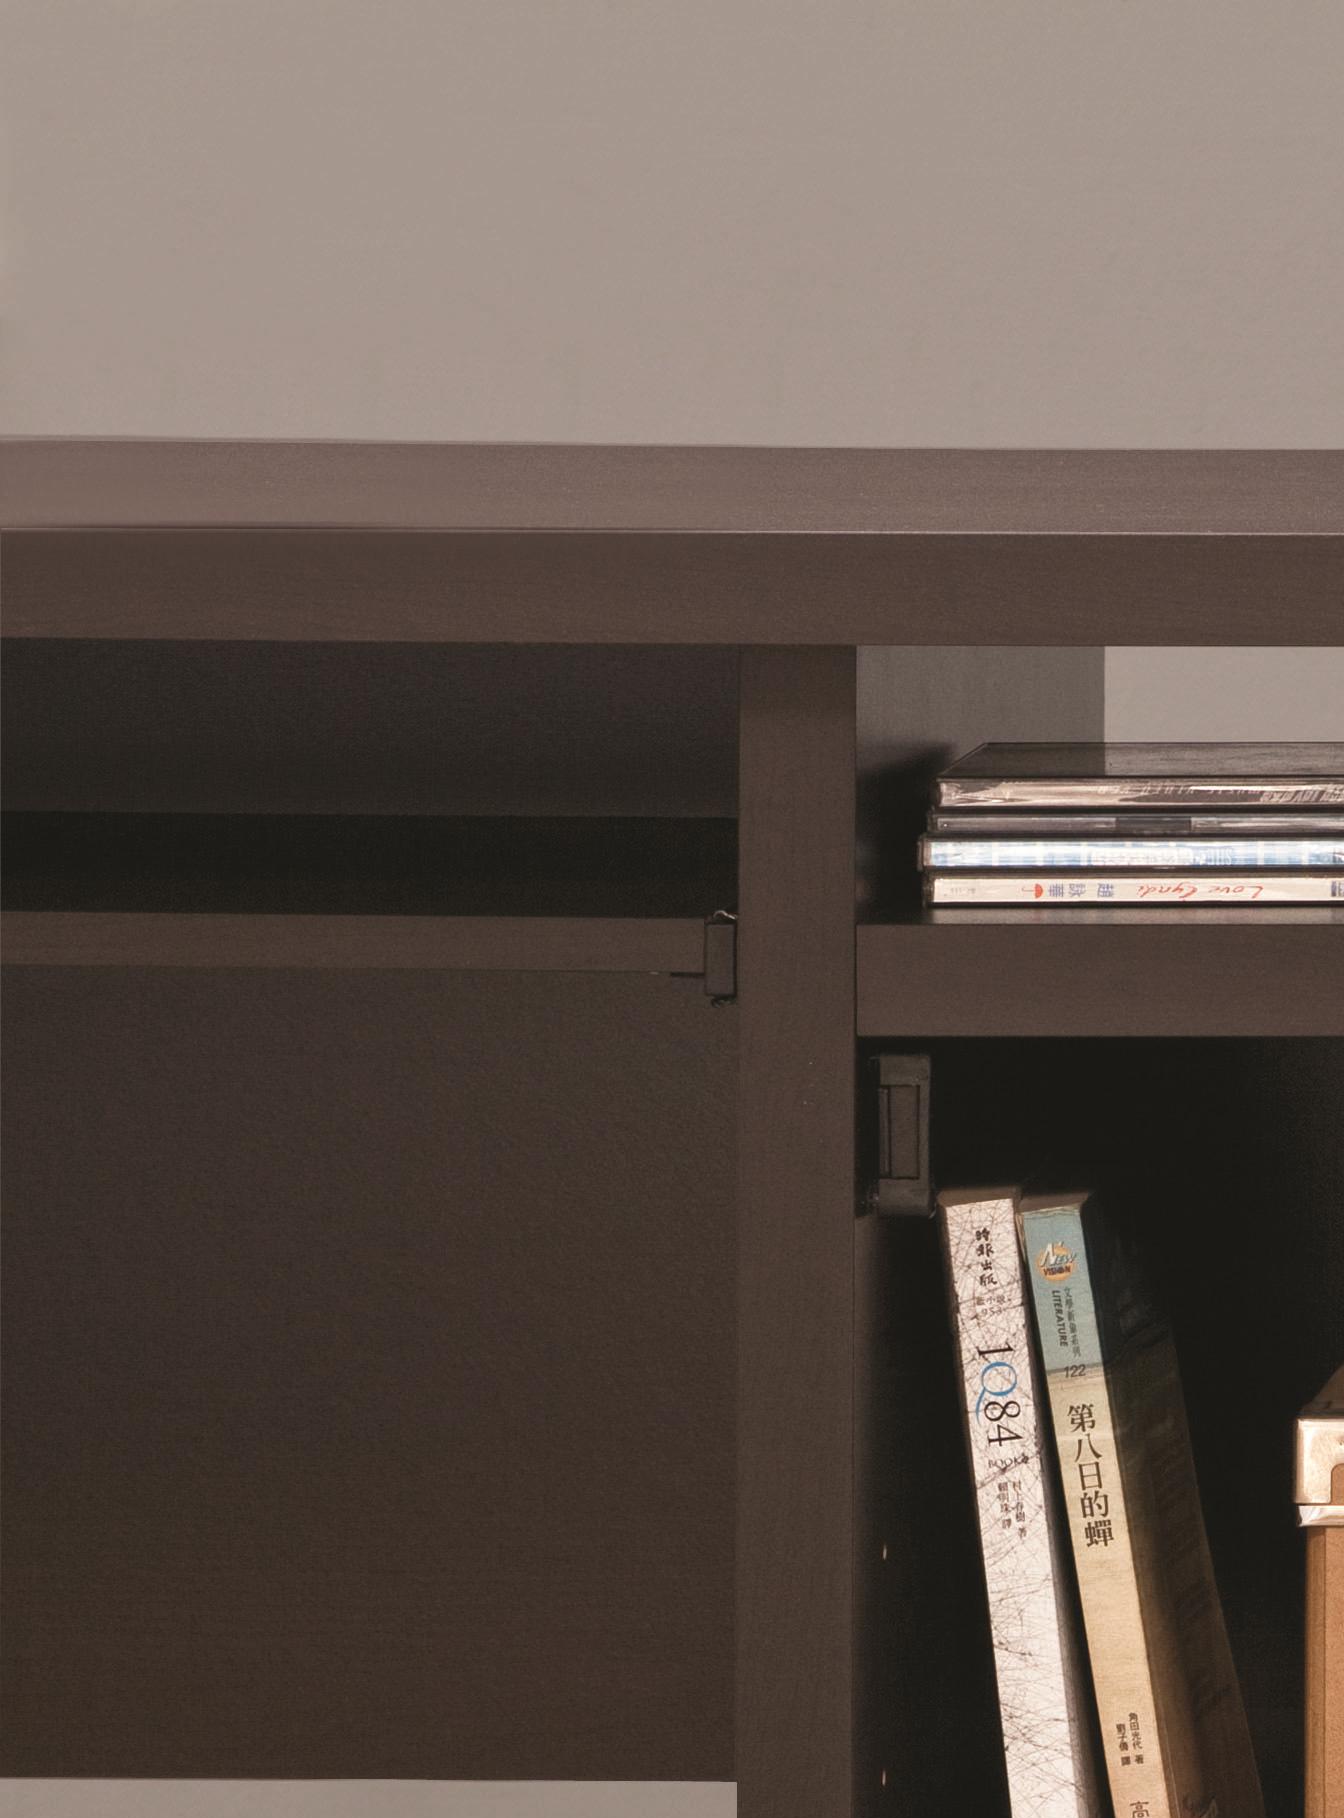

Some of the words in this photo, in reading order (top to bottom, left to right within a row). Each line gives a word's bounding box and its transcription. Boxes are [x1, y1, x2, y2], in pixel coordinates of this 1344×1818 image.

[1051, 1289, 1069, 1348] LITERATURE
[976, 1342, 1024, 1447] 1Q84
[1063, 1364, 1086, 1378] 122
[1067, 1403, 1115, 1547] 第八日的蟬
